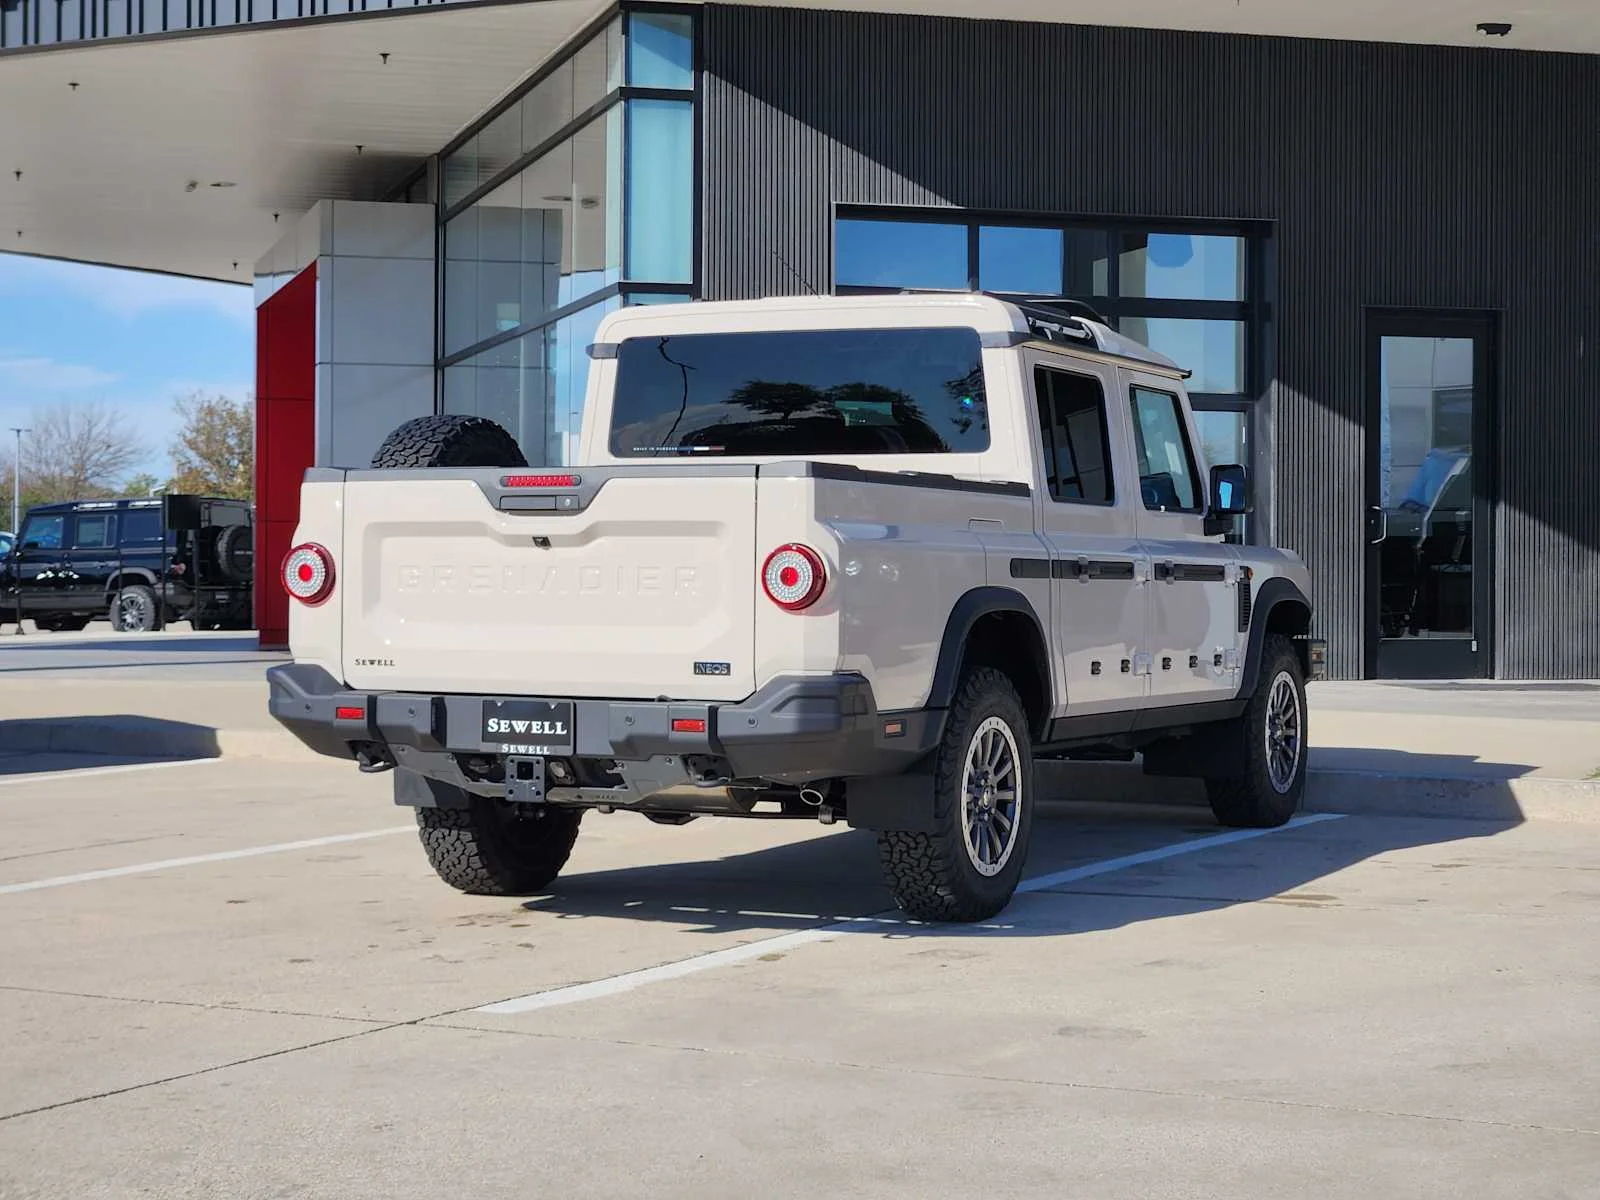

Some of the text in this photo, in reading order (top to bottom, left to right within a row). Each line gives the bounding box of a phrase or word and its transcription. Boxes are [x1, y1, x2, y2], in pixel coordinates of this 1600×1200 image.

[397, 564, 699, 595] GRENADIER
[354, 658, 396, 667] SEWELL
[695, 663, 728, 674] INEOS
[487, 717, 567, 735] SEWELL
[501, 744, 550, 754] SEWELL
